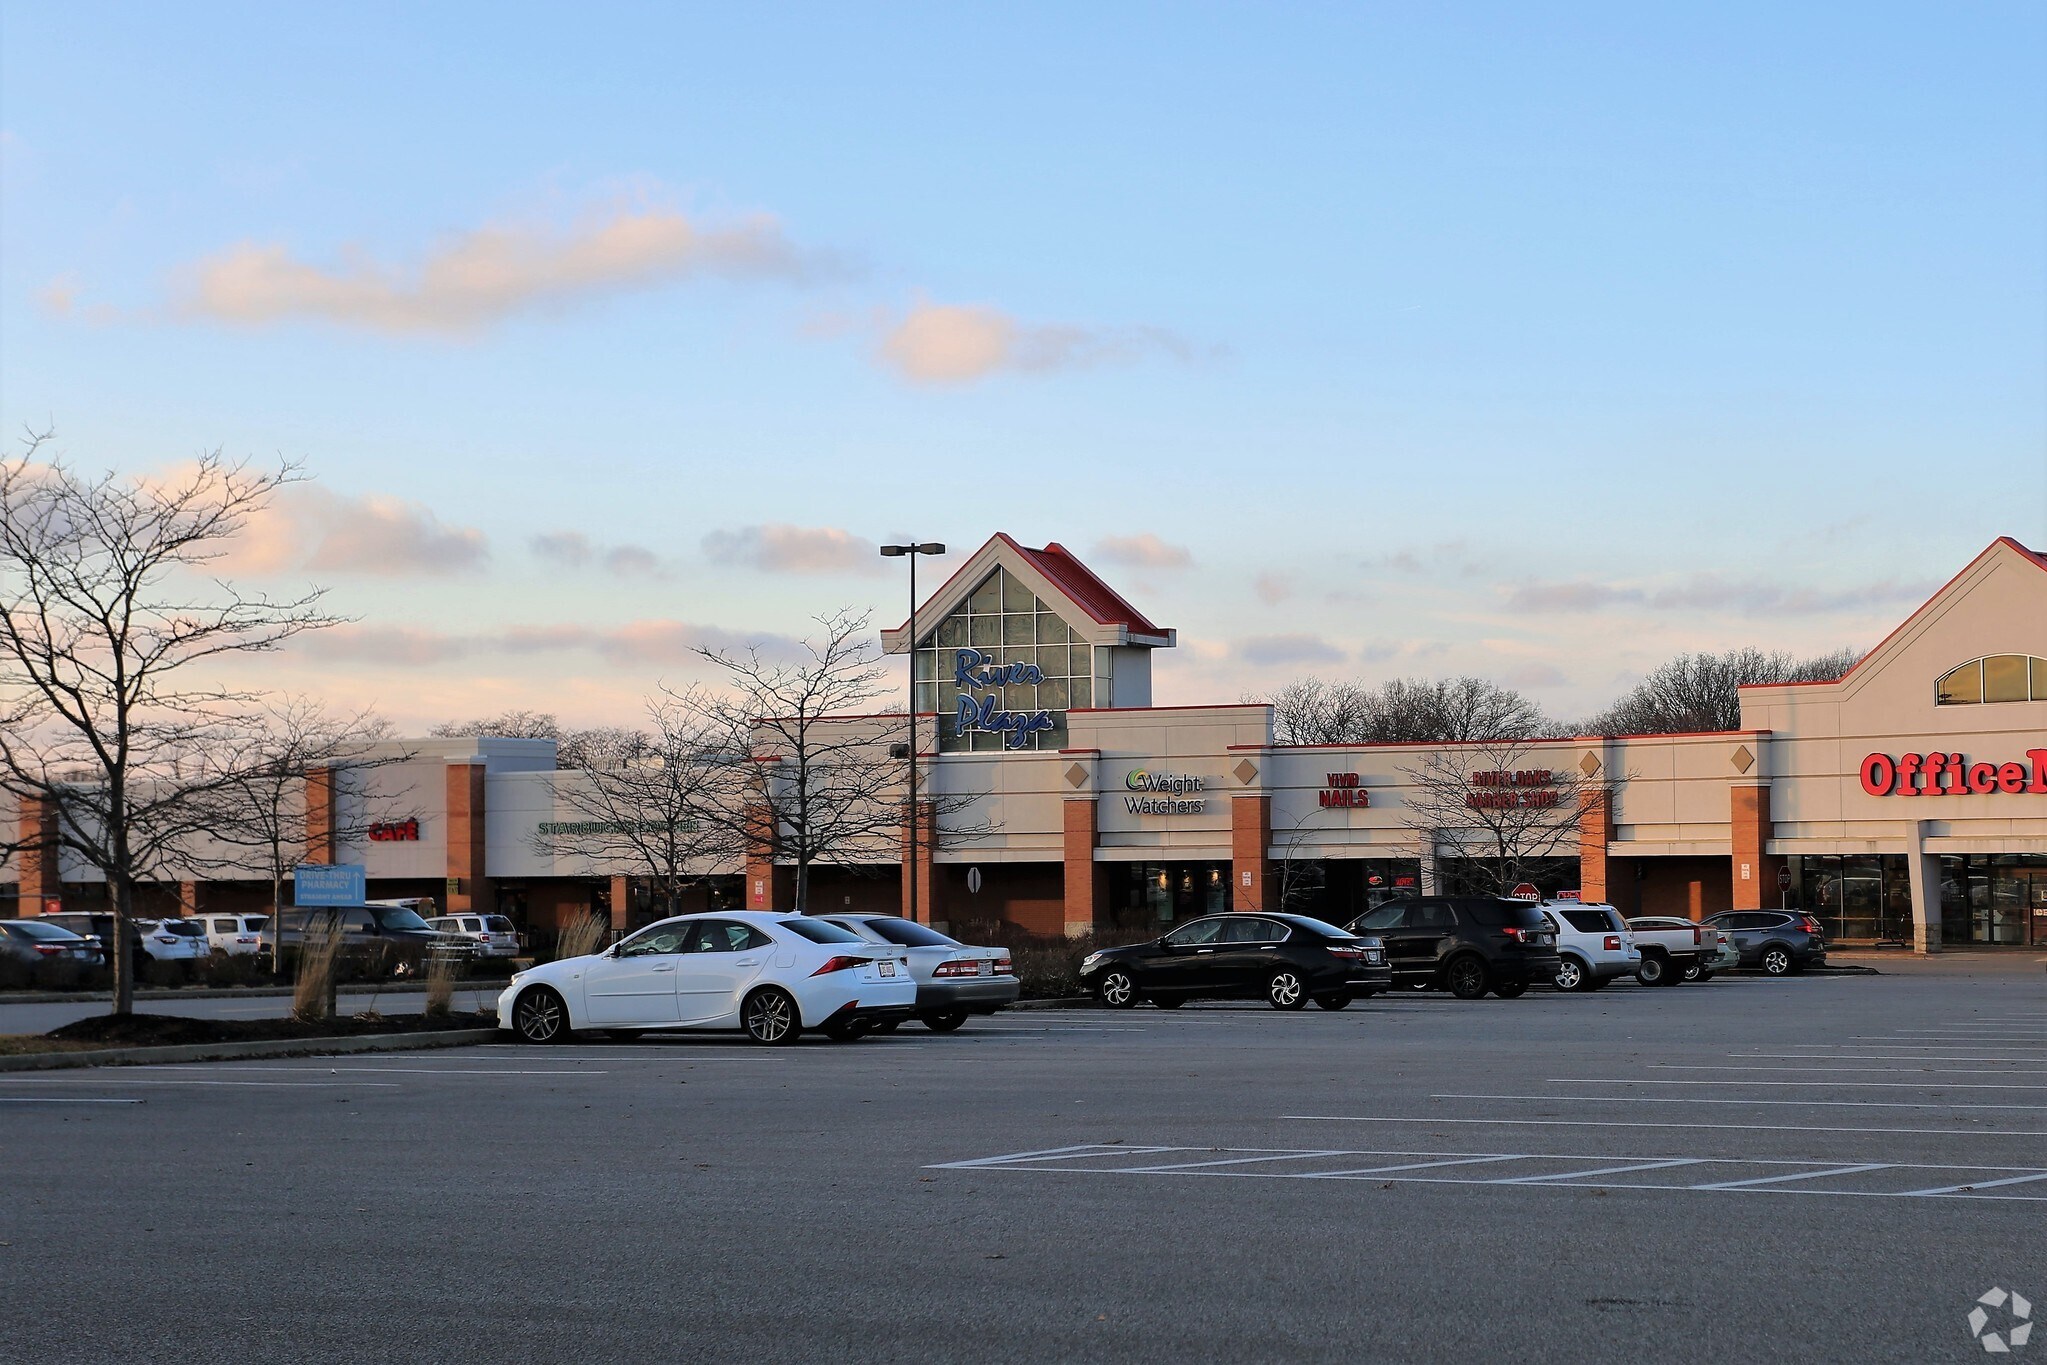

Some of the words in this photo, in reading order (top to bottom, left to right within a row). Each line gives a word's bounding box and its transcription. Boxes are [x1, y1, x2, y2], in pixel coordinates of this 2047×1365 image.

[955, 648, 1045, 690] River
[955, 693, 1054, 749] Plaza
[1140, 774, 1201, 797] Weight
[1326, 772, 1360, 787] VIVID
[1473, 771, 1512, 786] RIVER
[1516, 770, 1552, 786] OAKS
[1124, 796, 1204, 815] Watchers
[1319, 789, 1369, 807] NAILS
[1466, 792, 1518, 808] BARBER
[1522, 791, 1558, 808] SHOP
[538, 821, 634, 835] STARBUCKS
[300, 871, 351, 880] DRIVE-THRU
[301, 880, 350, 889] PHARMACY
